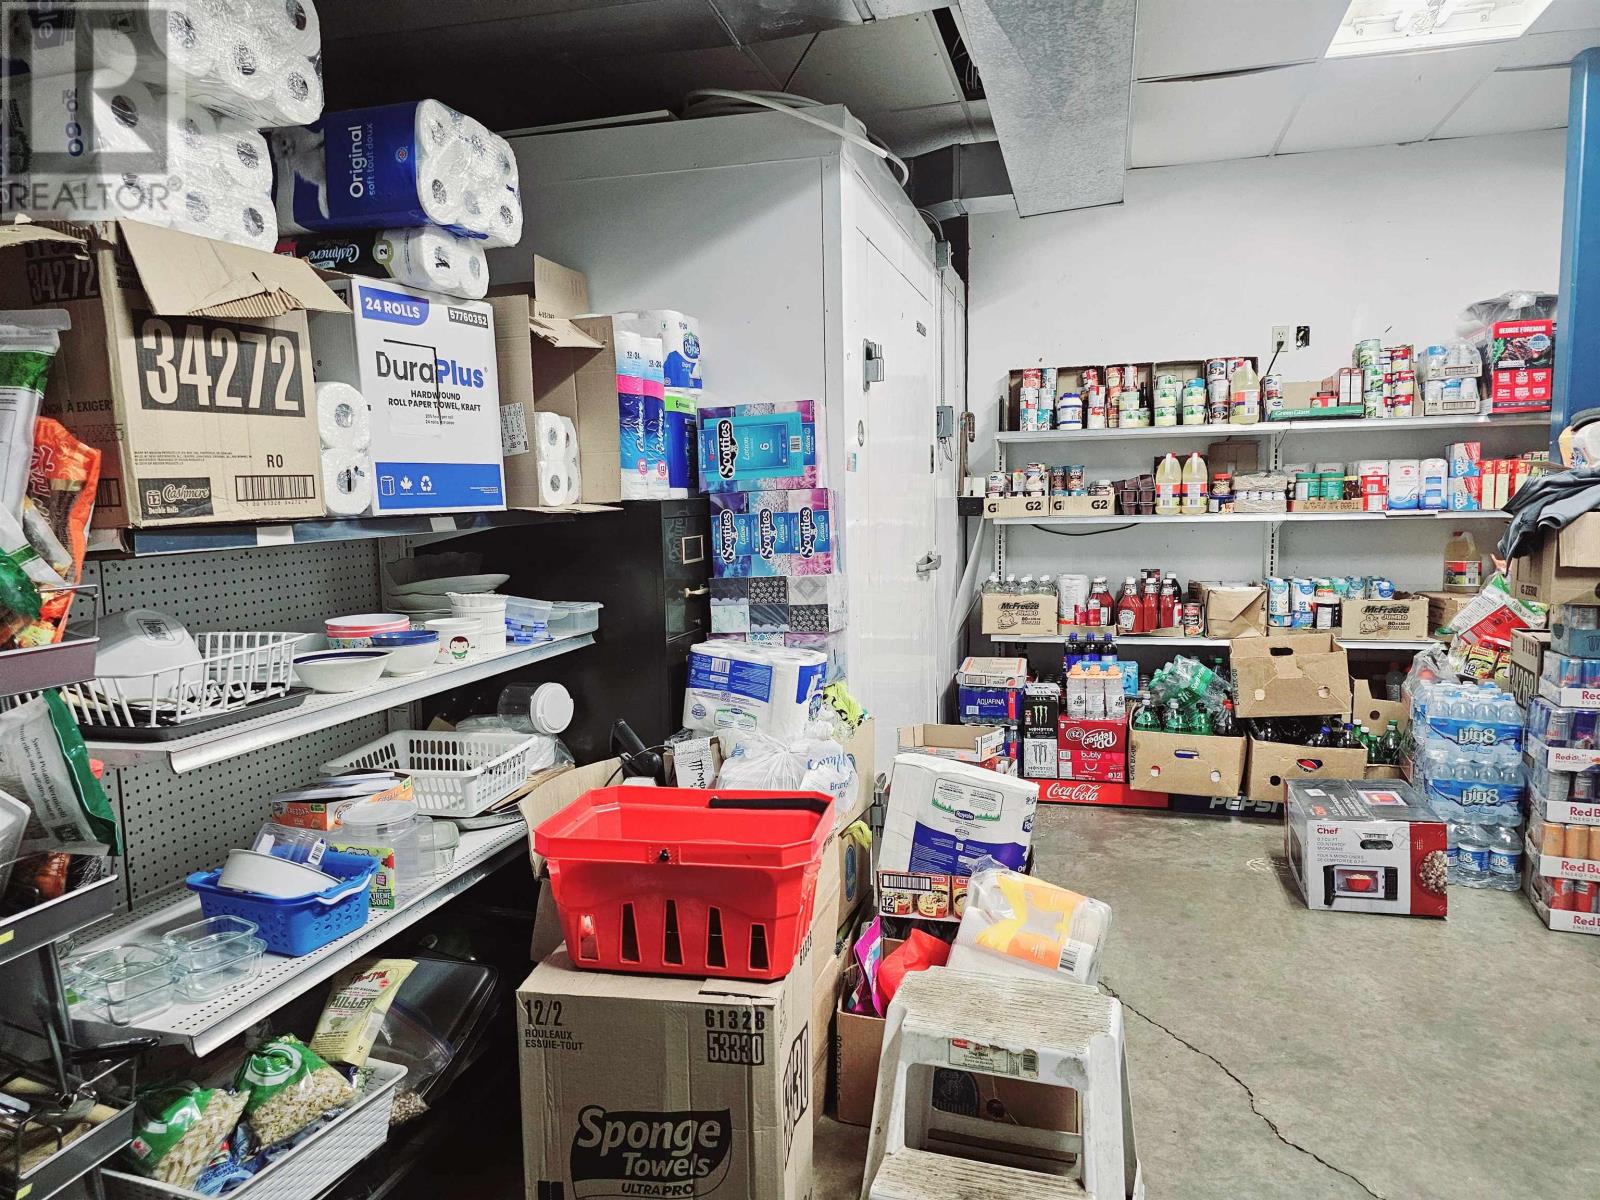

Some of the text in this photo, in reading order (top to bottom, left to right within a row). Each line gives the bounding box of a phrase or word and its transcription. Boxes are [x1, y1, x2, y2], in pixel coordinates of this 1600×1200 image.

[349, 125, 367, 198] Original
[308, 243, 360, 263] Cashmere
[365, 297, 421, 319] 24 ROLLS
[450, 308, 487, 327] 57760352
[141, 318, 299, 411] 34272
[376, 350, 485, 389] DuraPlus
[411, 389, 461, 401] HARDWOUND
[76, 399, 111, 412] EXIGER
[388, 397, 481, 412] ROLL PAPER TOWEL, KRAFT
[718, 422, 735, 478] Scotties
[760, 443, 769, 451] 6
[266, 454, 284, 468] RO
[148, 495, 161, 505] 12
[162, 483, 210, 503] Cashmere
[1025, 501, 1041, 511] G2
[1091, 500, 1108, 510] G2
[721, 513, 735, 559] Scotties
[760, 510, 773, 557] Scotties
[800, 509, 814, 556] Scotties
[1466, 663, 1476, 674] 12
[976, 698, 1005, 706] AQUAFINA
[1209, 795, 1278, 813] PEPSI
[1570, 806, 1592, 817] Red
[1317, 827, 1338, 835] Chef
[1561, 861, 1586, 873] Red
[882, 896, 894, 906] 12
[1573, 915, 1596, 926] Red
[525, 999, 563, 1027] 12/2
[704, 1008, 765, 1031] 61328
[525, 1028, 573, 1041] ROULEAUX
[525, 1039, 584, 1051] ESSUIE-TOUT
[577, 1104, 721, 1157] Sponge
[622, 1152, 711, 1178] Towels
